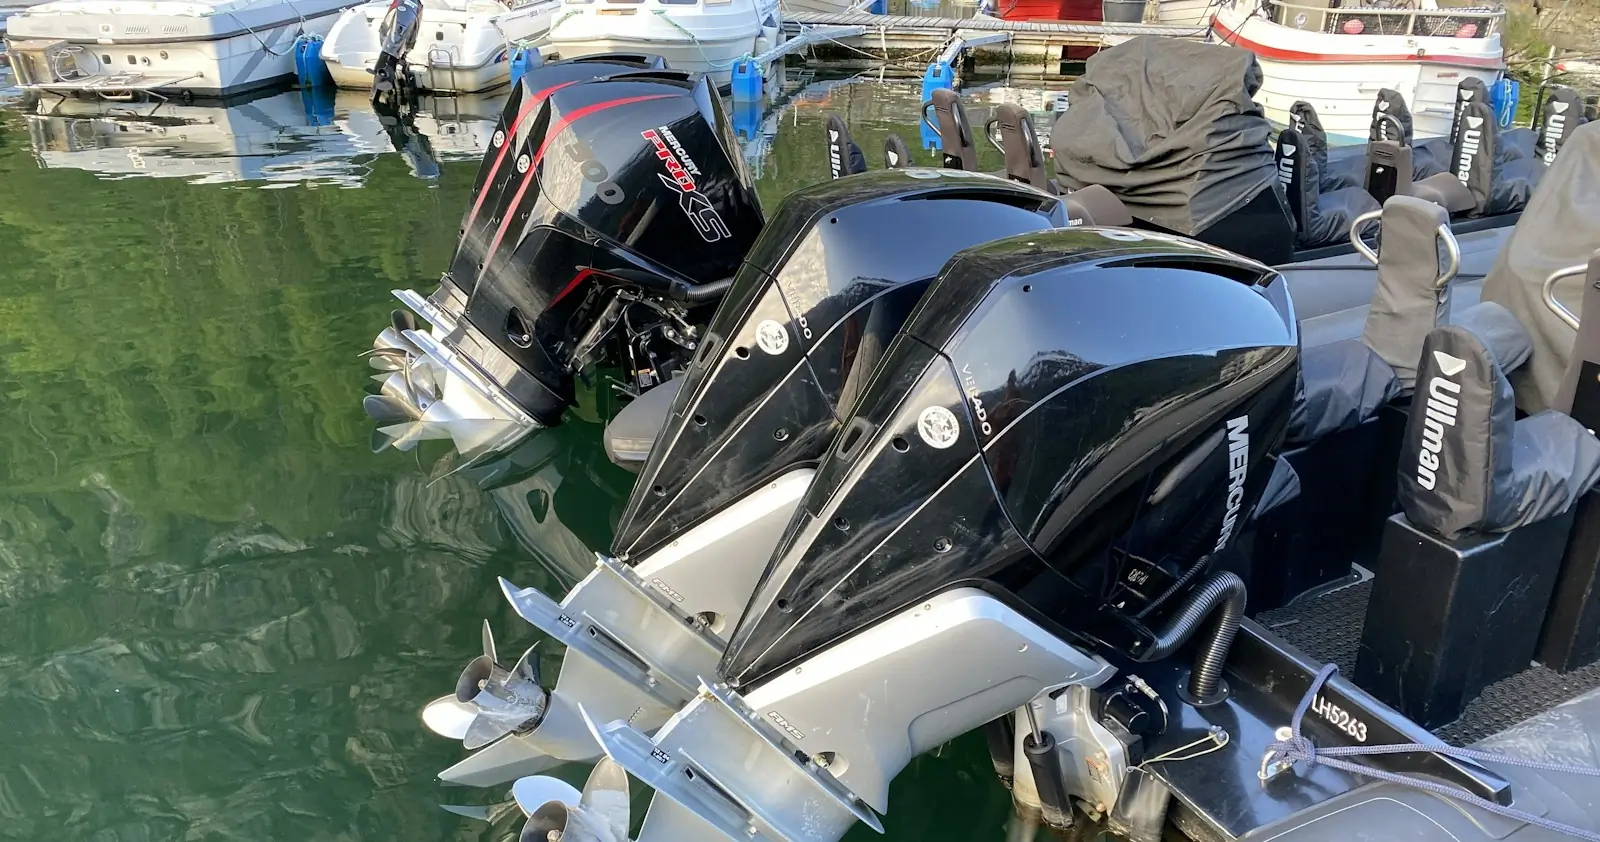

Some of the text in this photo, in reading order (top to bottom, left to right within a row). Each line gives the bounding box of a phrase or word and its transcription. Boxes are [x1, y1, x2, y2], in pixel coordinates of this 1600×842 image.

[640, 128, 733, 243] PRO XS
[658, 125, 702, 176] MERCURY
[1416, 375, 1462, 492] Ullman
[1311, 692, 1368, 743] LH5263
